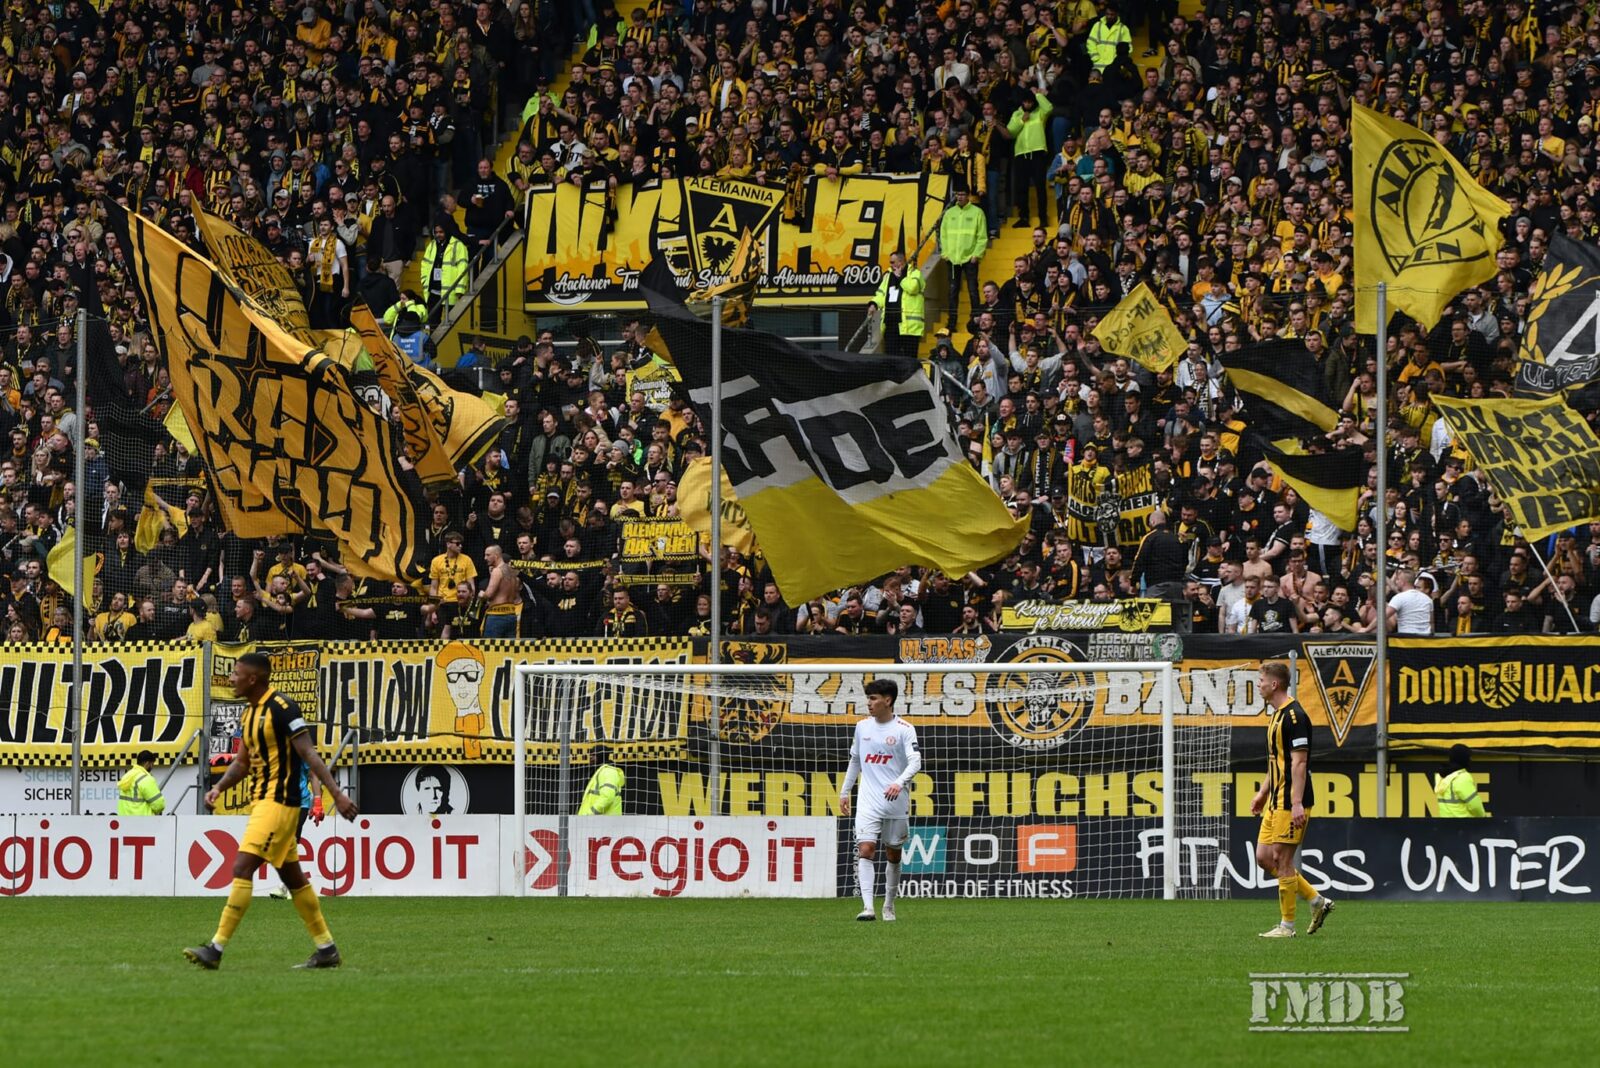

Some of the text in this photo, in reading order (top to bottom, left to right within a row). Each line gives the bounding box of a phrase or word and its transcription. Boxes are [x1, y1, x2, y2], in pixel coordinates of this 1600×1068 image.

[690, 179, 774, 204] ALEMANNIA
[709, 203, 738, 232] A
[554, 273, 611, 293] Aachener
[773, 267, 839, 287] Alemannia
[843, 265, 882, 285] 1900
[1013, 598, 1123, 618] Keine Sekunde
[1027, 615, 1050, 635] je
[901, 637, 976, 661] ULTRAS
[1015, 636, 1073, 655] KARLS
[1089, 632, 1154, 645] LEGENDEN
[1088, 645, 1132, 660] STERBEN
[1312, 647, 1374, 657] ALEMANNIA
[1332, 659, 1356, 685] A
[1399, 664, 1478, 705] DOM
[1, 657, 197, 744] ULTRAS
[320, 658, 433, 745] YELLOW
[1009, 733, 1066, 751] BANDE
[864, 753, 893, 765] HIT
[25, 769, 72, 782] SICHER
[25, 788, 72, 801] SICHER
[657, 772, 935, 817] WERNR
[954, 771, 1165, 817] FUCHS
[109, 820, 156, 880] iT
[432, 819, 479, 880] iT
[588, 820, 750, 897] regio
[767, 820, 815, 882] iT
[1400, 835, 1592, 895] UNTER
[964, 879, 987, 899] OF
[995, 879, 1074, 899] FITNESS
